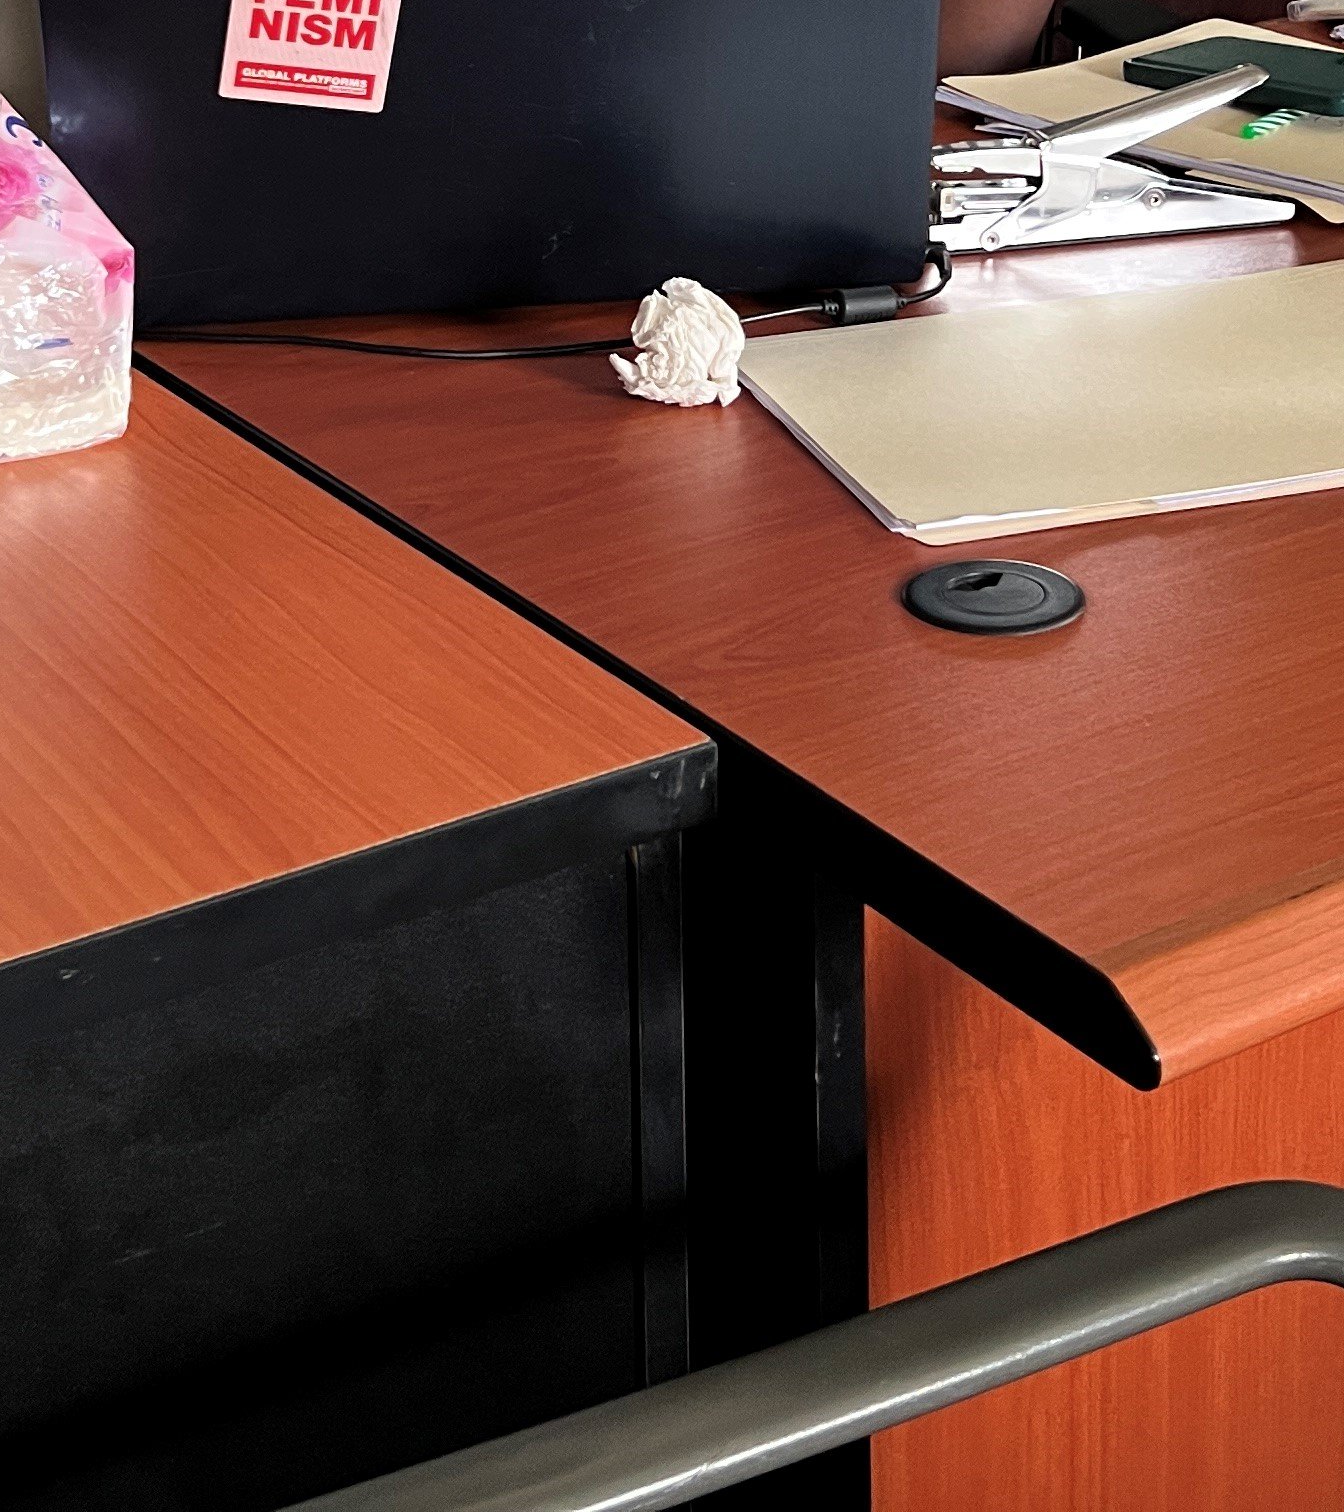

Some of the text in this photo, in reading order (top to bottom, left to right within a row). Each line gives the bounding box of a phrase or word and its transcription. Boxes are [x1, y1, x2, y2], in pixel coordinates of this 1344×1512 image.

[249, 7, 377, 51] NISM
[242, 67, 369, 89] GLOBAL PLATFORMS
